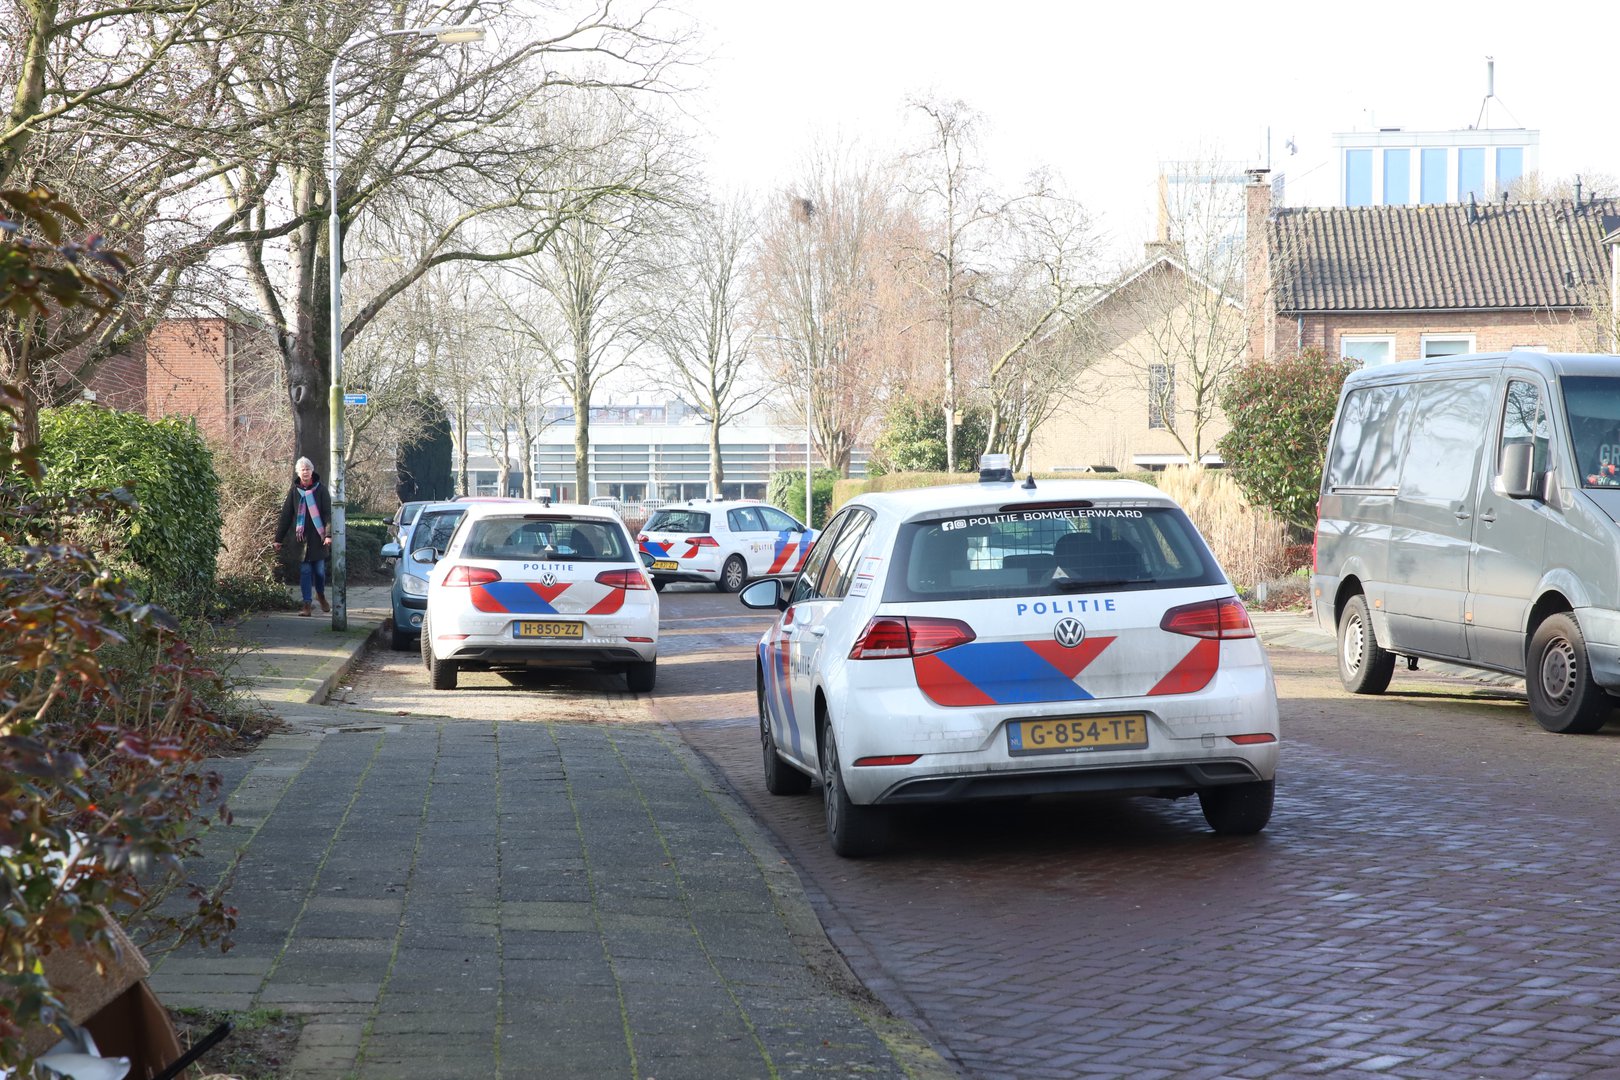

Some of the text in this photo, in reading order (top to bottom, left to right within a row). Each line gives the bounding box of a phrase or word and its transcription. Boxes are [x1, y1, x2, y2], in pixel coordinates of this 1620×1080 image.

[969, 509, 1143, 527] POLITIE BOMMELERWAARD
[523, 563, 574, 571] POLITIE
[1016, 599, 1116, 616] POLITIE
[524, 623, 579, 635] H-850-ZZ
[1030, 720, 1136, 745] G-854-TF
